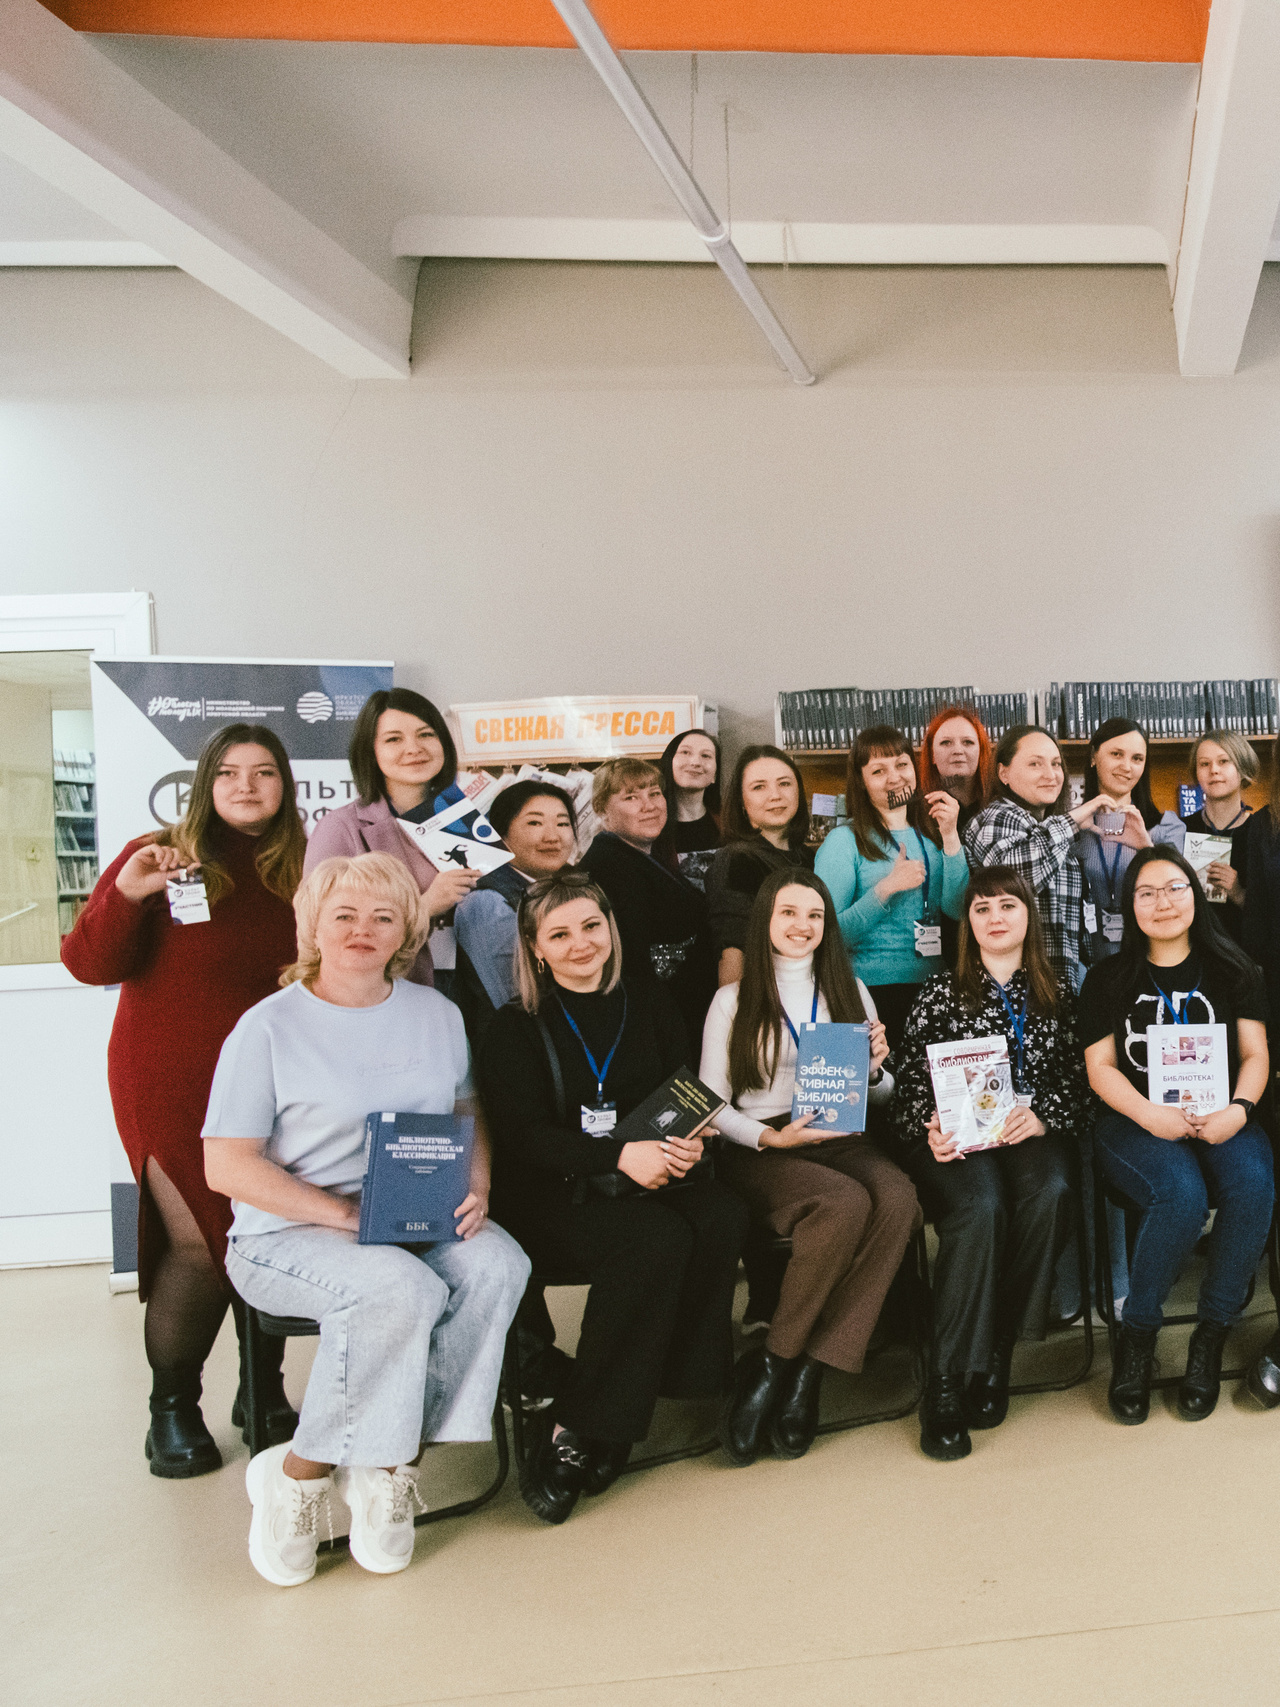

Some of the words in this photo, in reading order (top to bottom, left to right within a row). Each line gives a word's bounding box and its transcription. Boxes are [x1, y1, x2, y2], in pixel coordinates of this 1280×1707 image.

[475, 714, 565, 744] СВЕЖАЯ
[577, 711, 676, 738] ПРЕССА
[296, 780, 355, 799] ЛЬТ
[800, 1066, 844, 1076] ЭФФЕК-
[800, 1078, 845, 1089] ТИВНАЯ
[797, 1092, 848, 1102] БИБЛИО-
[398, 1136, 452, 1144] БИБЛИОТЕЧНО-
[385, 1143, 464, 1153] БИБЛИОГРАФИЧЕСКАЯ
[392, 1151, 456, 1160] КЛАССИФИКАЦИЯ
[406, 1222, 430, 1231] ББК
